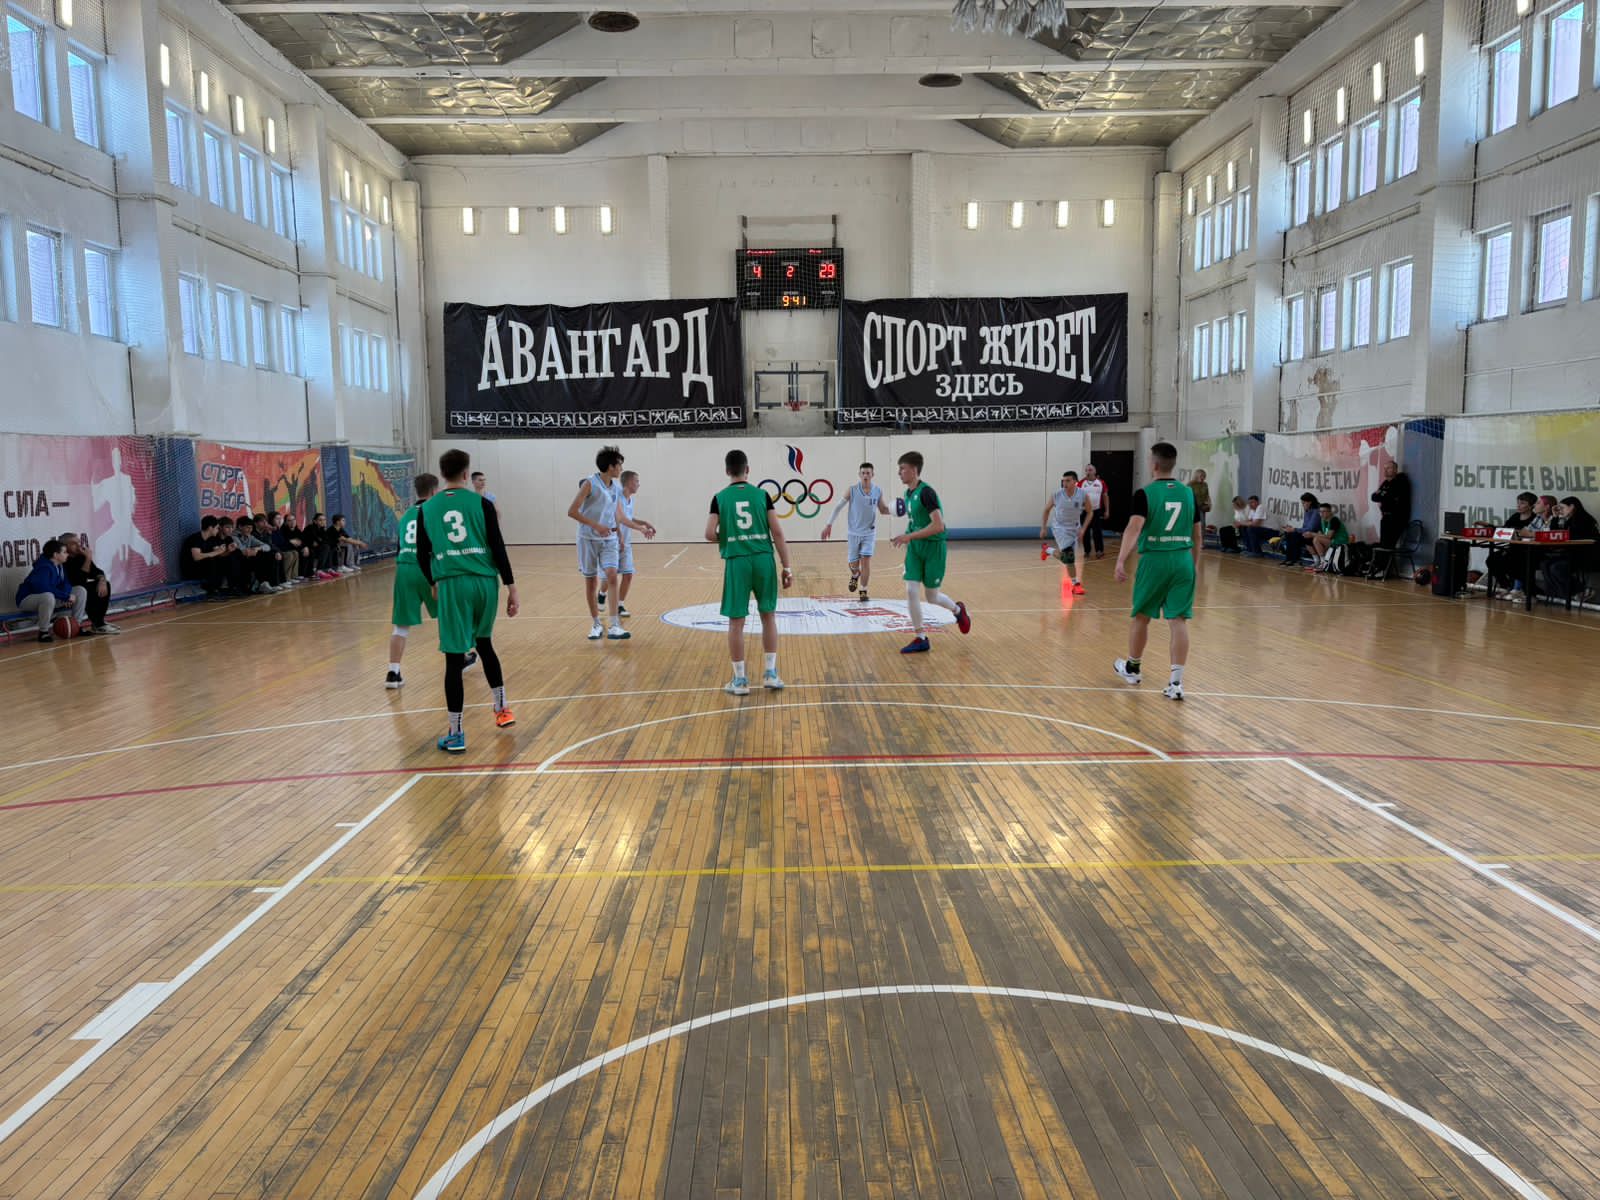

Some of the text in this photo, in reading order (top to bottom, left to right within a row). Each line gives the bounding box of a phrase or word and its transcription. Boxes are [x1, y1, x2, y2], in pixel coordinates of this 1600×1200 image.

[786, 265, 794, 278] 2
[477, 306, 715, 405] АВАНГАРД
[863, 306, 1097, 390] СПОРТ ЖИВЕТ
[935, 373, 1024, 402] ЗДЕСЬ
[442, 509, 468, 544] 3
[735, 500, 753, 530] 5
[1164, 501, 1183, 532] 7
[404, 519, 417, 544] 8
